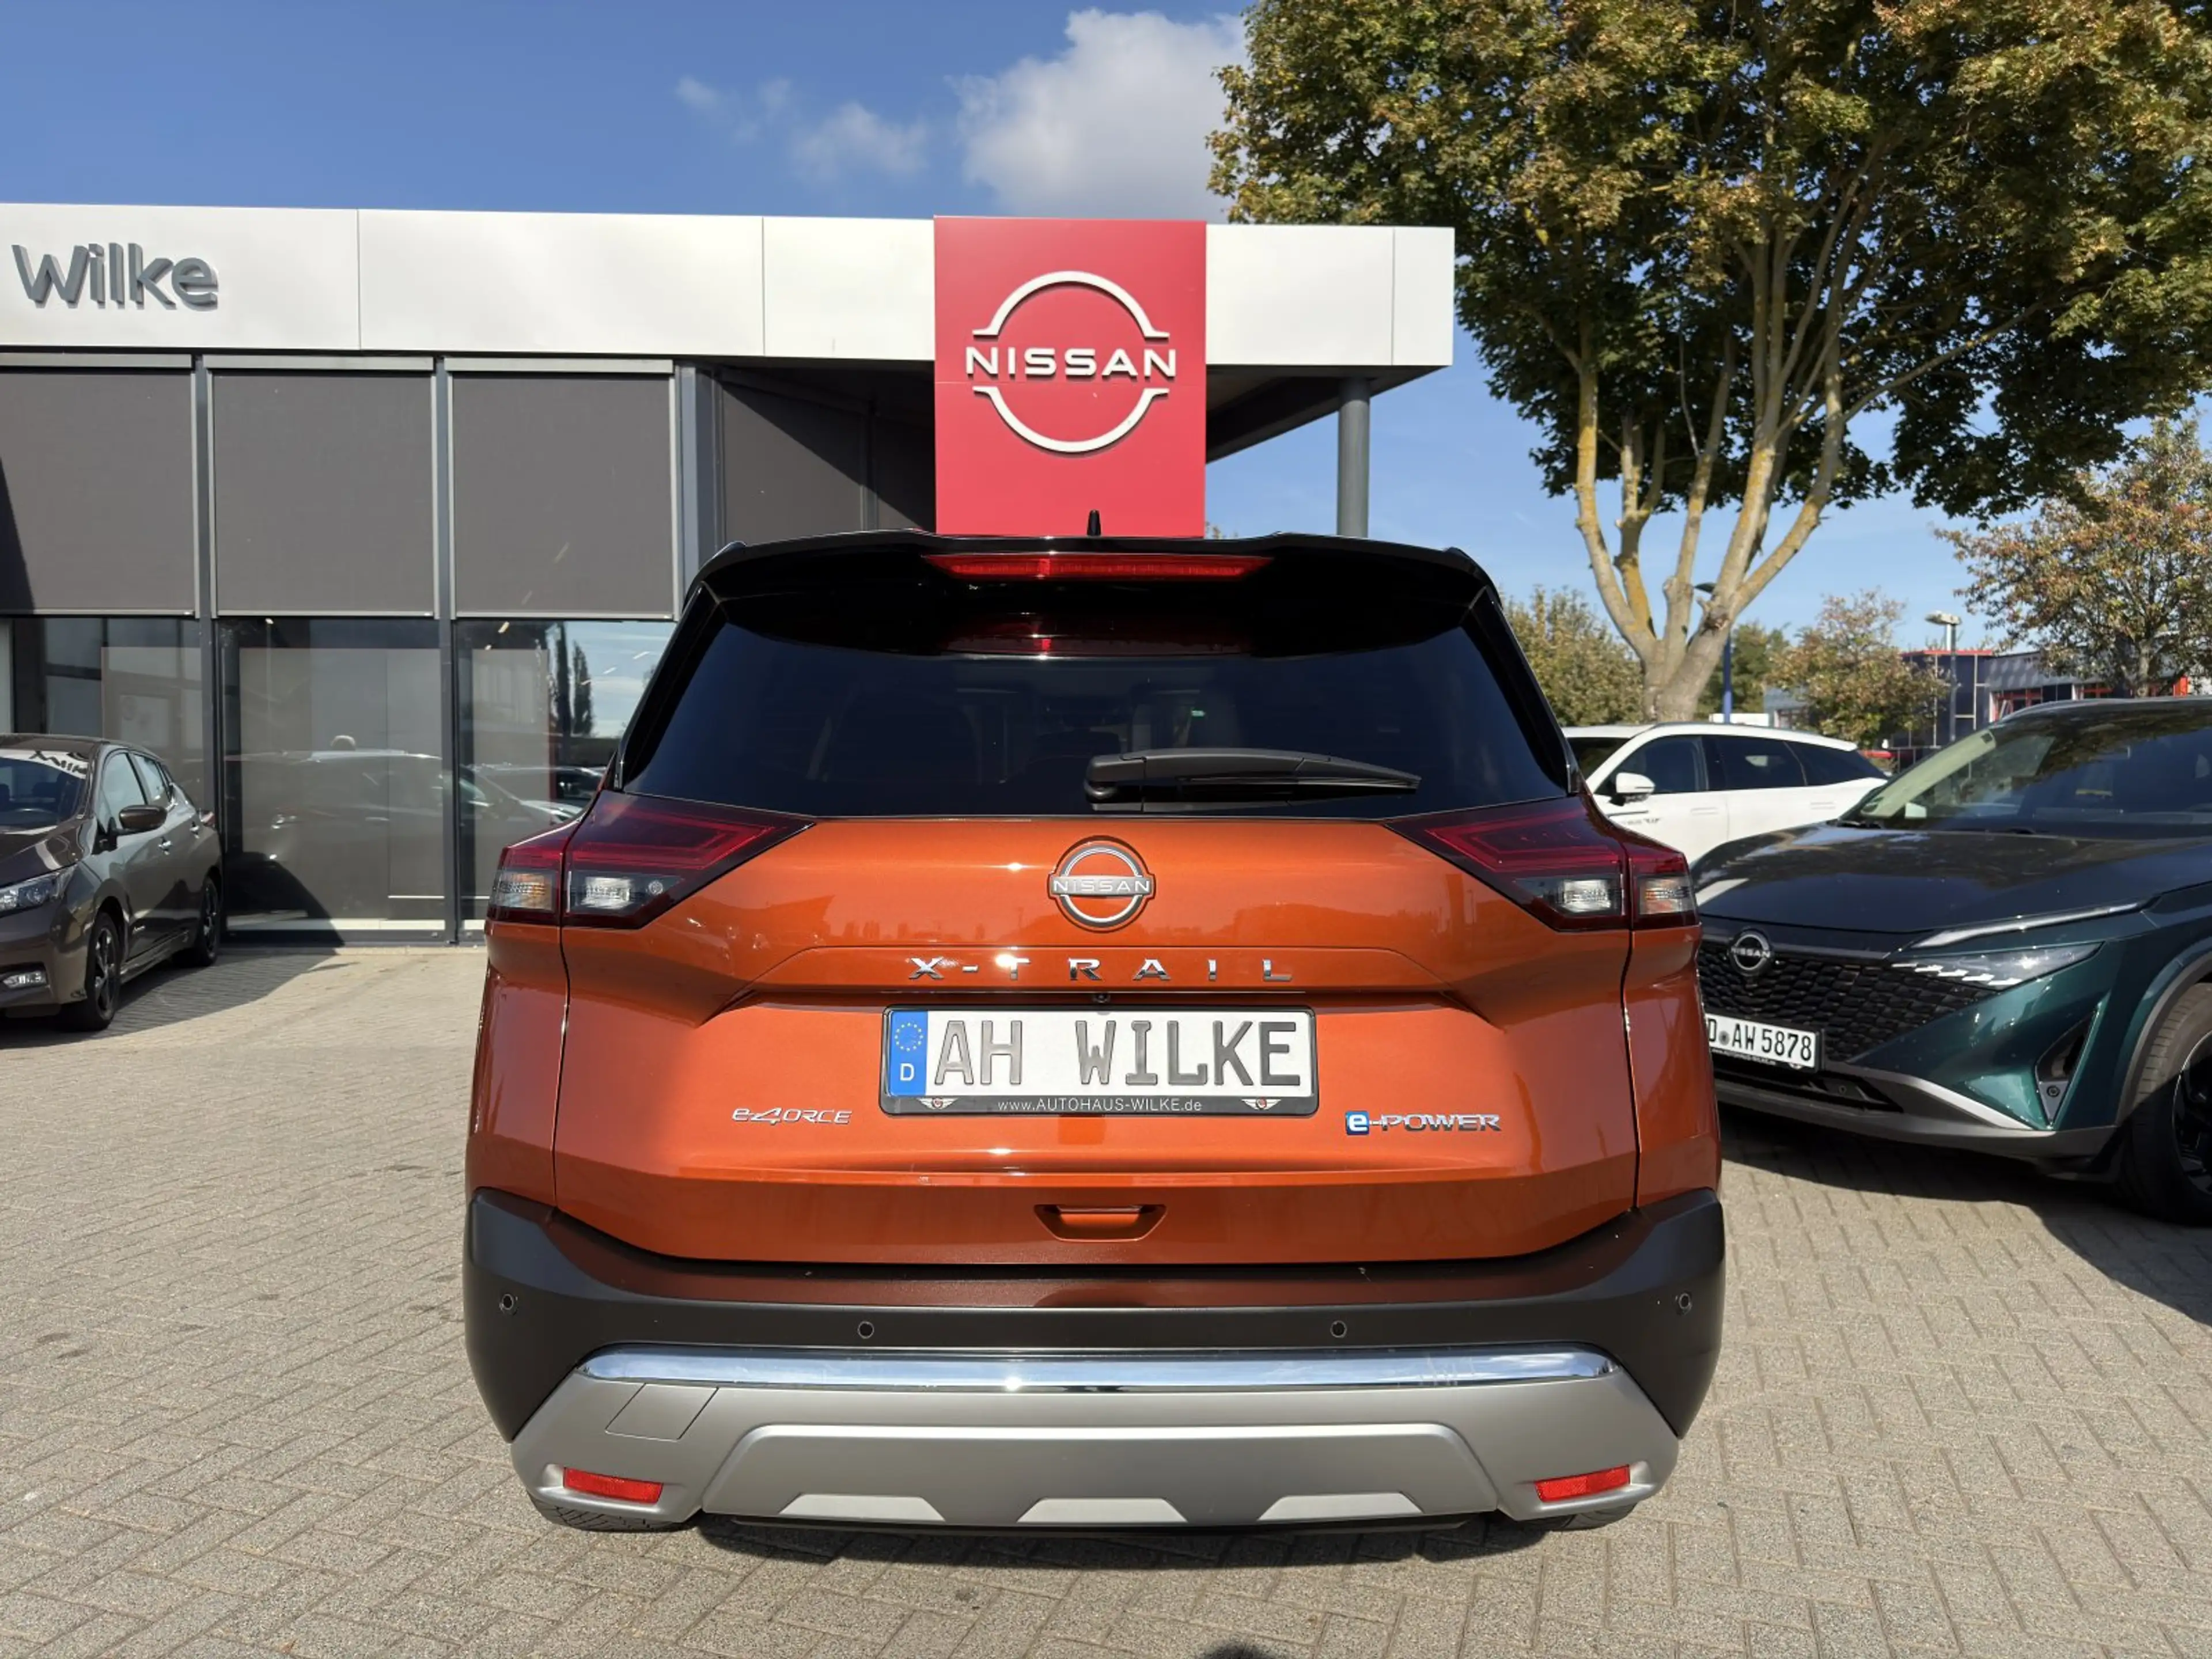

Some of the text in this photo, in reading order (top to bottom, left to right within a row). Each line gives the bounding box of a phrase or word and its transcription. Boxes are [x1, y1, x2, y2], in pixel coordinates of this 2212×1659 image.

[12, 243, 218, 310] Wilke
[965, 346, 1176, 379] NISSAN
[1053, 880, 1150, 892] NISSAN
[908, 957, 1292, 981] X-TRAIL
[934, 1020, 1301, 1086] AH WILKE
[1732, 1023, 1756, 1051] AW
[1762, 1028, 1812, 1061] 5878
[900, 1063, 915, 1081] D
[997, 1097, 1202, 1111] www.AUTOHAUS-WILKE.de
[1346, 1112, 1502, 1133] e-POWER
